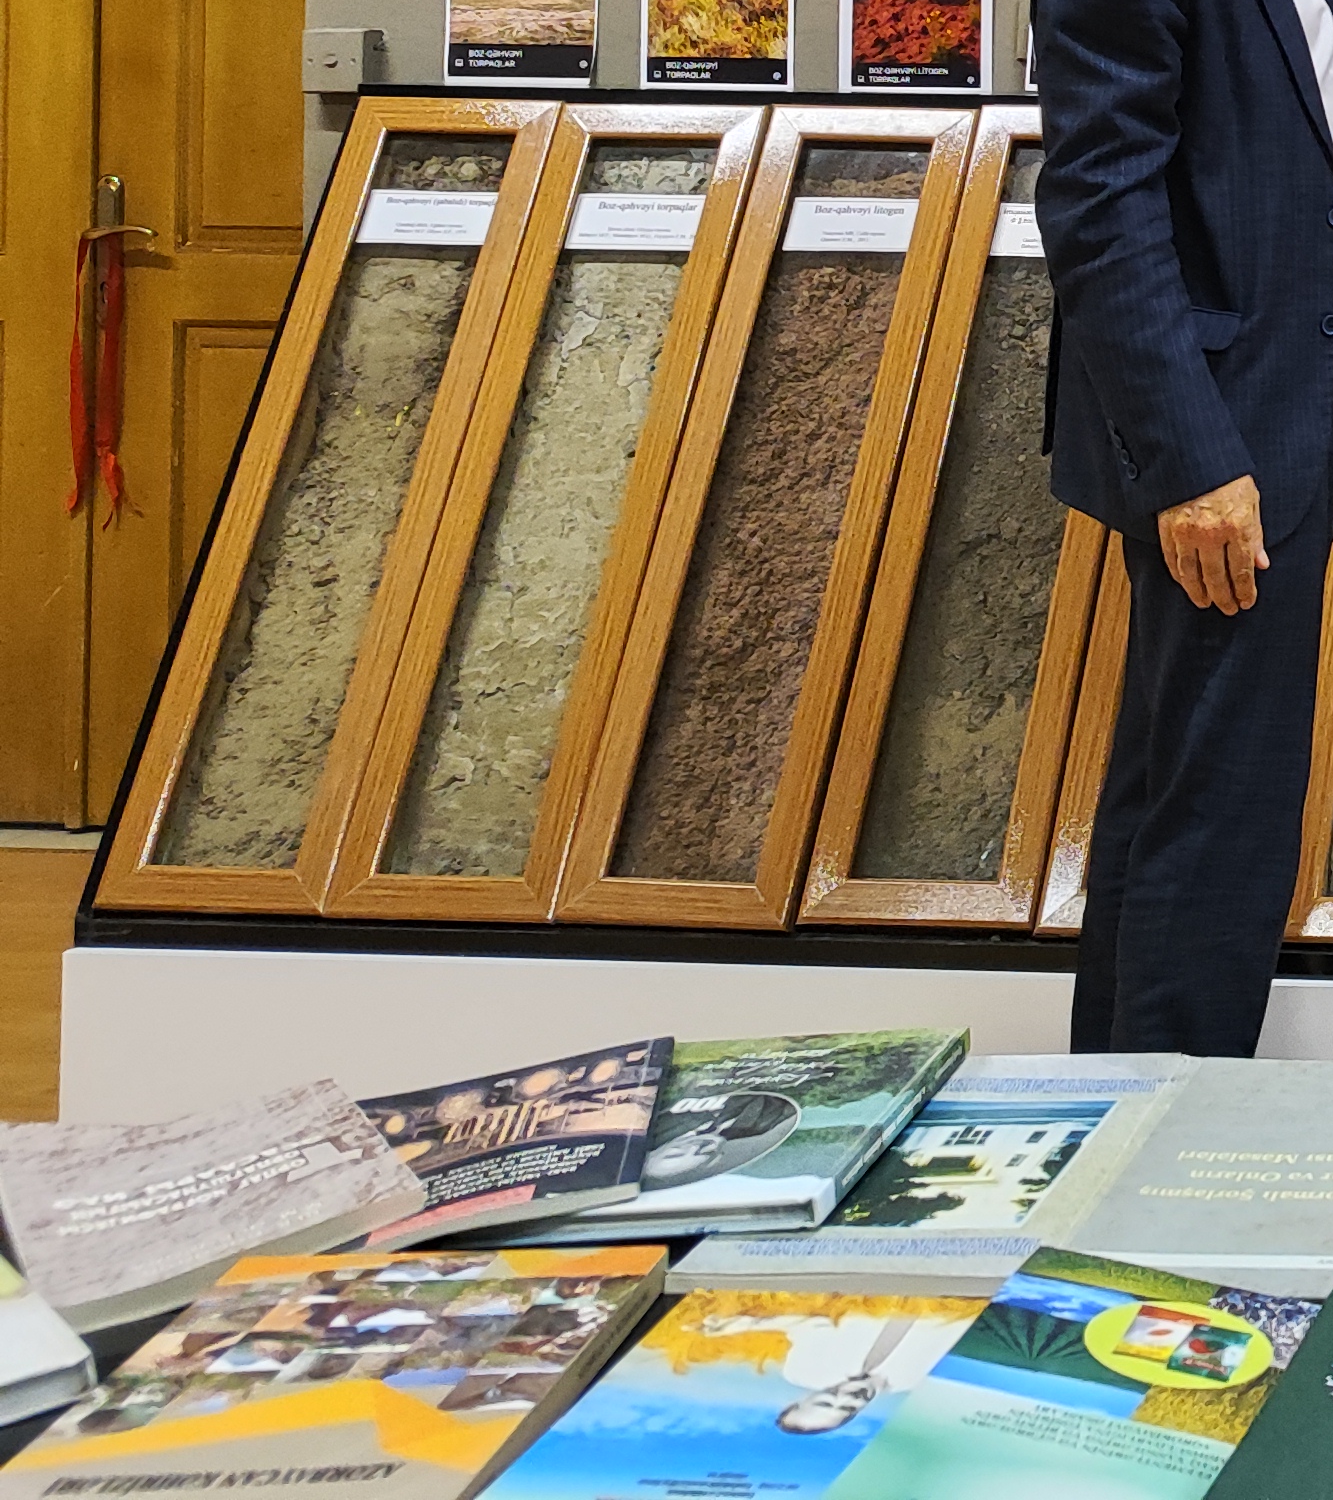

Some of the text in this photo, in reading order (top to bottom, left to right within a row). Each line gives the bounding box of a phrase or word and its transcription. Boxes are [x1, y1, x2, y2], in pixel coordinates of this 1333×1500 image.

[1190, 1169, 1282, 1184] Onların
[1288, 1171, 1314, 1182] və
[1139, 1185, 1256, 1202] Şorlaşmış
